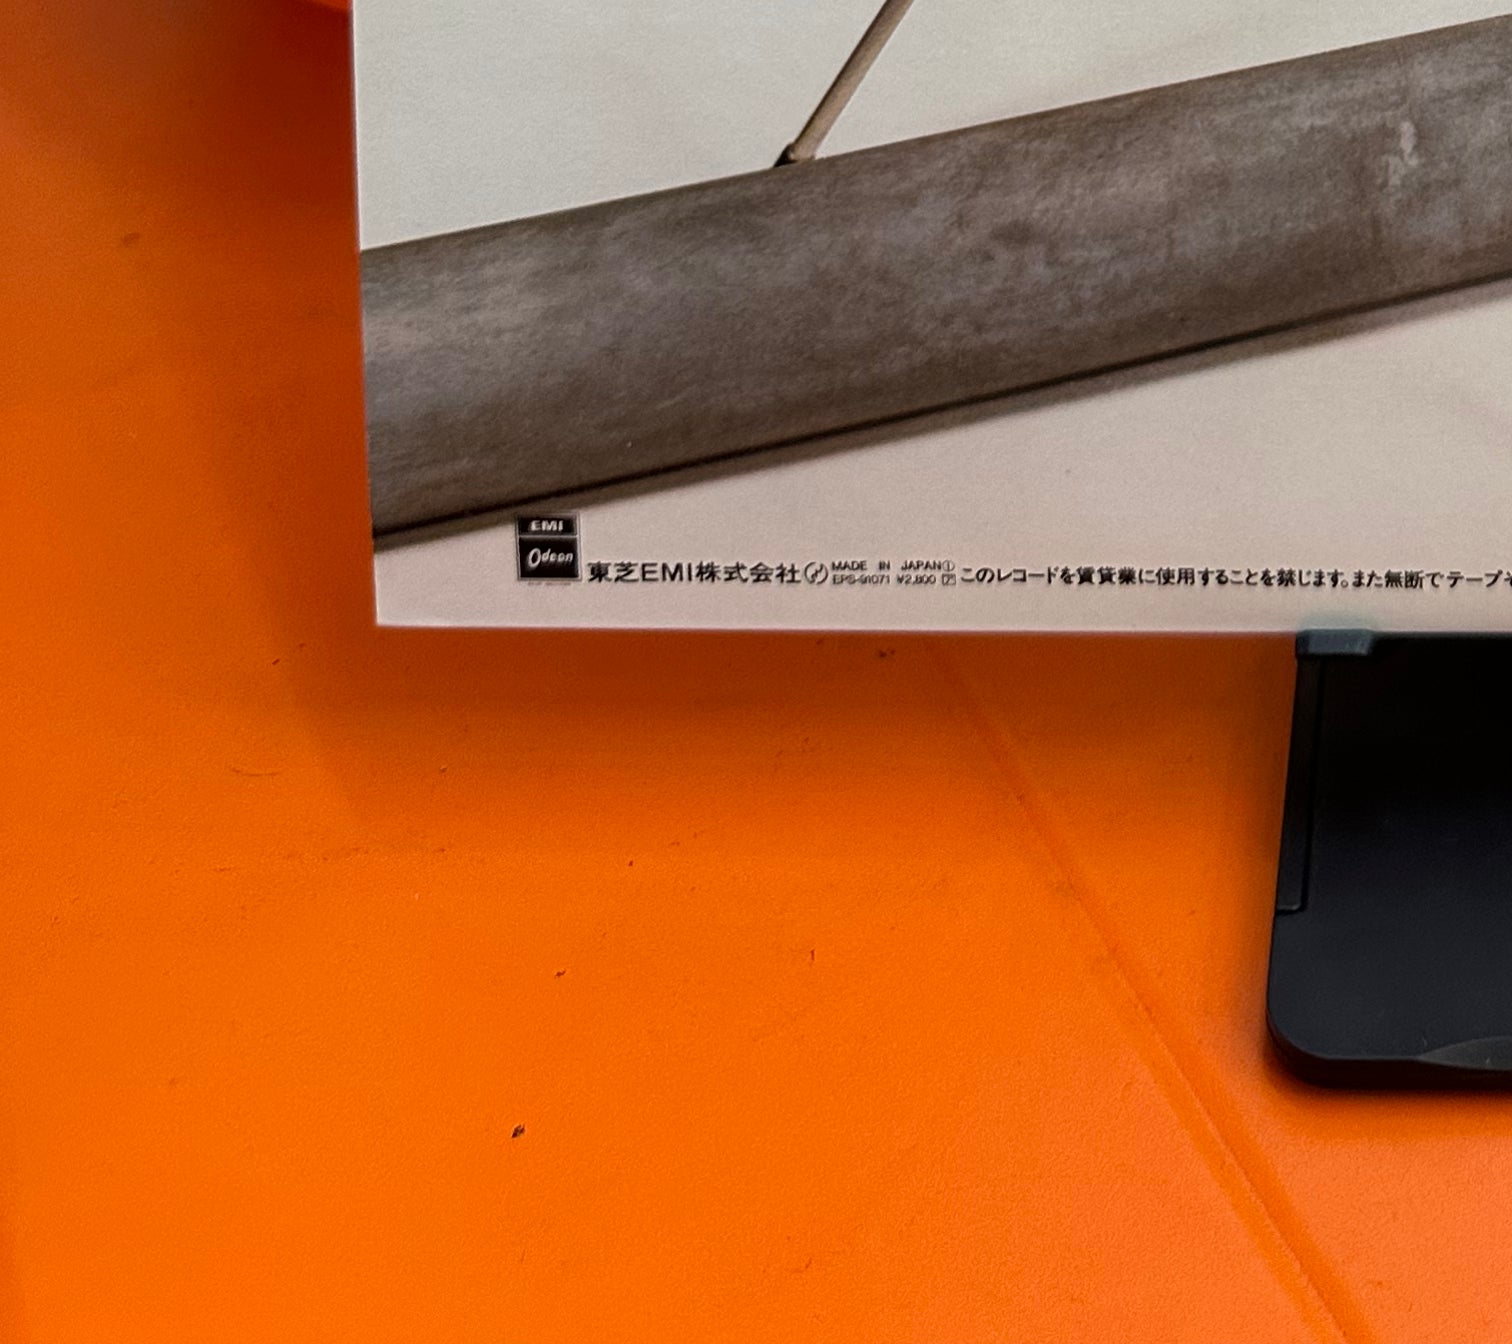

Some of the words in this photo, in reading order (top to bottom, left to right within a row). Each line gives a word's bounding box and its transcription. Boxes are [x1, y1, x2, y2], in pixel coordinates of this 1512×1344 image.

[530, 520, 564, 531] EMI
[528, 547, 574, 569] Odeon
[831, 560, 868, 571] MADE
[878, 560, 891, 571] IN
[588, 561, 801, 583] 東芝EMI株式会社
